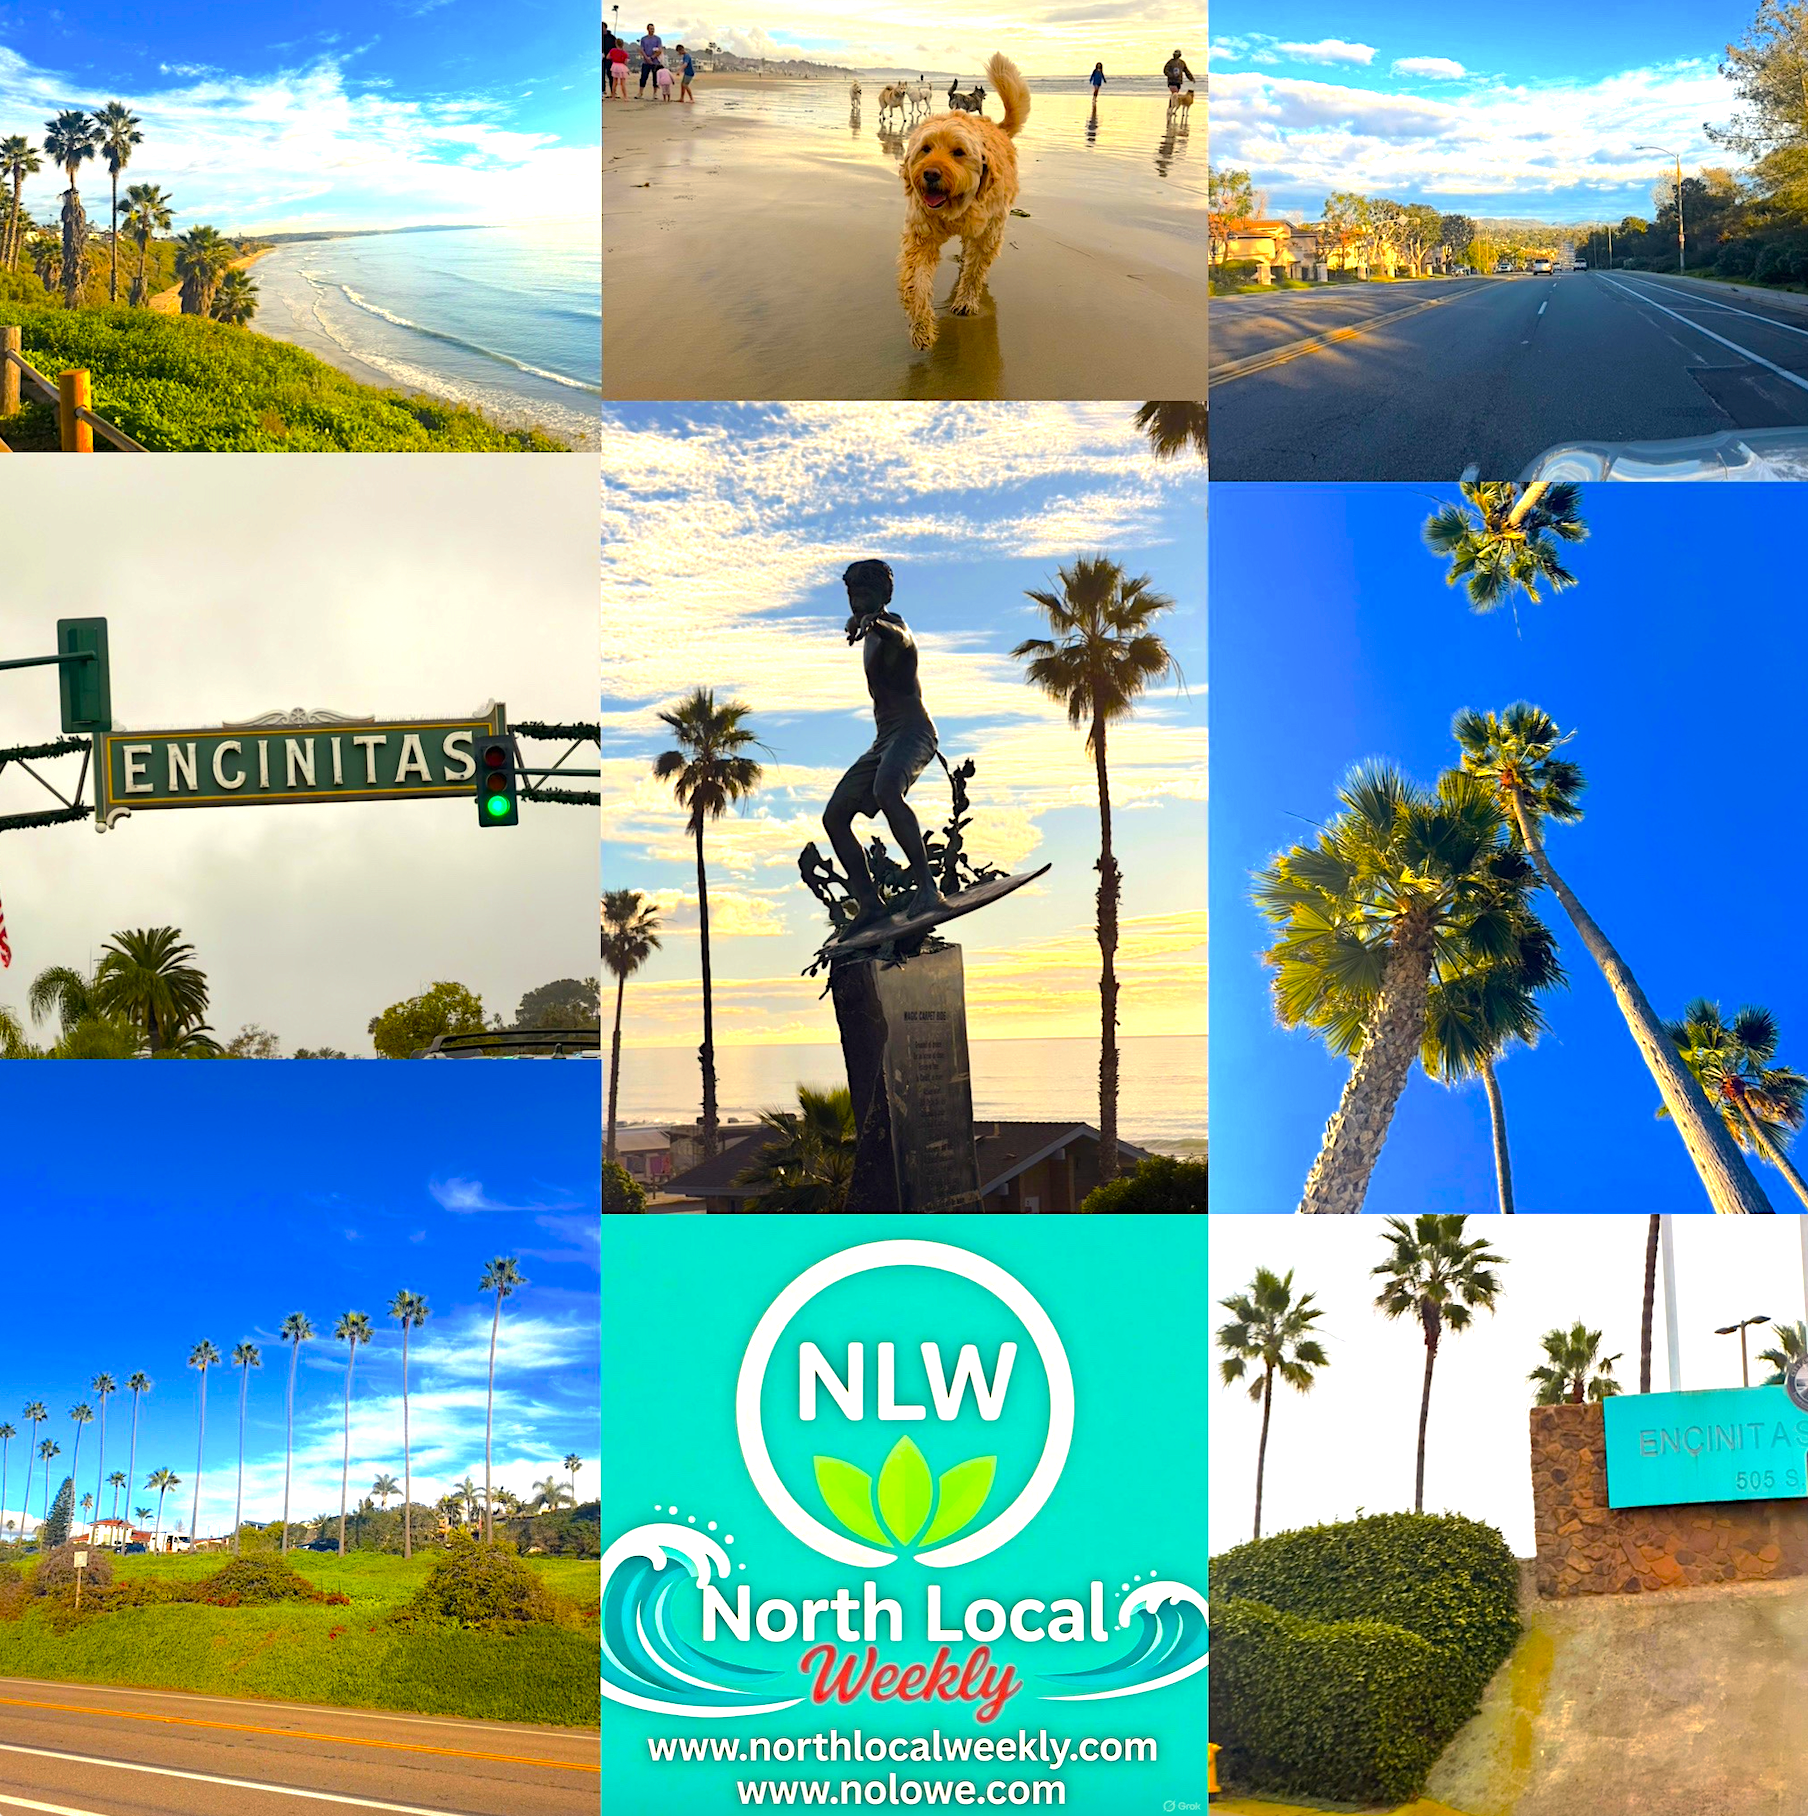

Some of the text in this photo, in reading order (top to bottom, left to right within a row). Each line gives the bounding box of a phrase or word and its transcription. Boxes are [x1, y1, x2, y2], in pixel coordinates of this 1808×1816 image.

[123, 730, 477, 794] ENCINITAS
[799, 1341, 1018, 1421] NLW
[1736, 1470, 1775, 1490] 505
[702, 1581, 1108, 1643] North Local
[800, 1644, 1022, 1724] Weekly
[647, 1729, 1157, 1770] www.northlocalweekly.com
[737, 1773, 1066, 1805] www.nolowe.com
